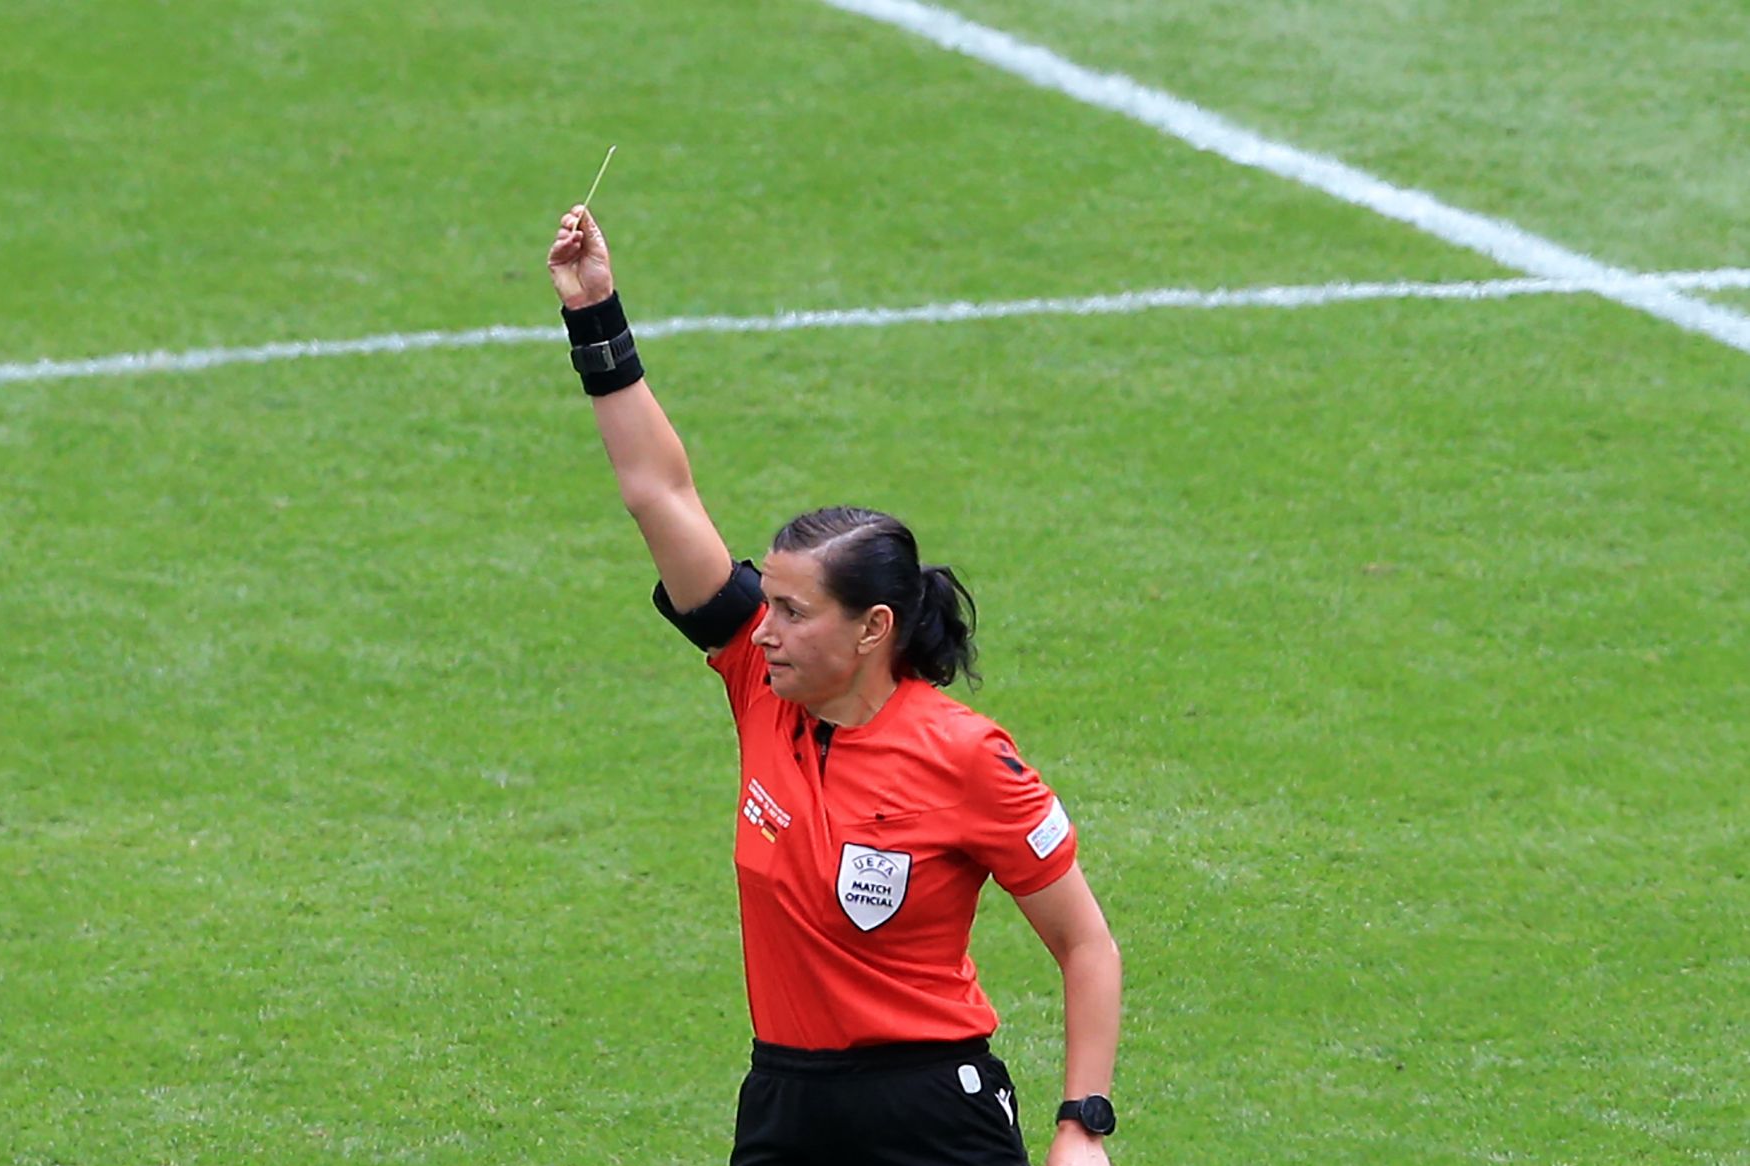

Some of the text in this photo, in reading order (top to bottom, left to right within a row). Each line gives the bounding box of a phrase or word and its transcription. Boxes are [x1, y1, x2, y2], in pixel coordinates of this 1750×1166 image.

[854, 857, 894, 877] UEFA
[851, 880, 892, 896] MATCH
[845, 892, 894, 908] OFFICIAL
